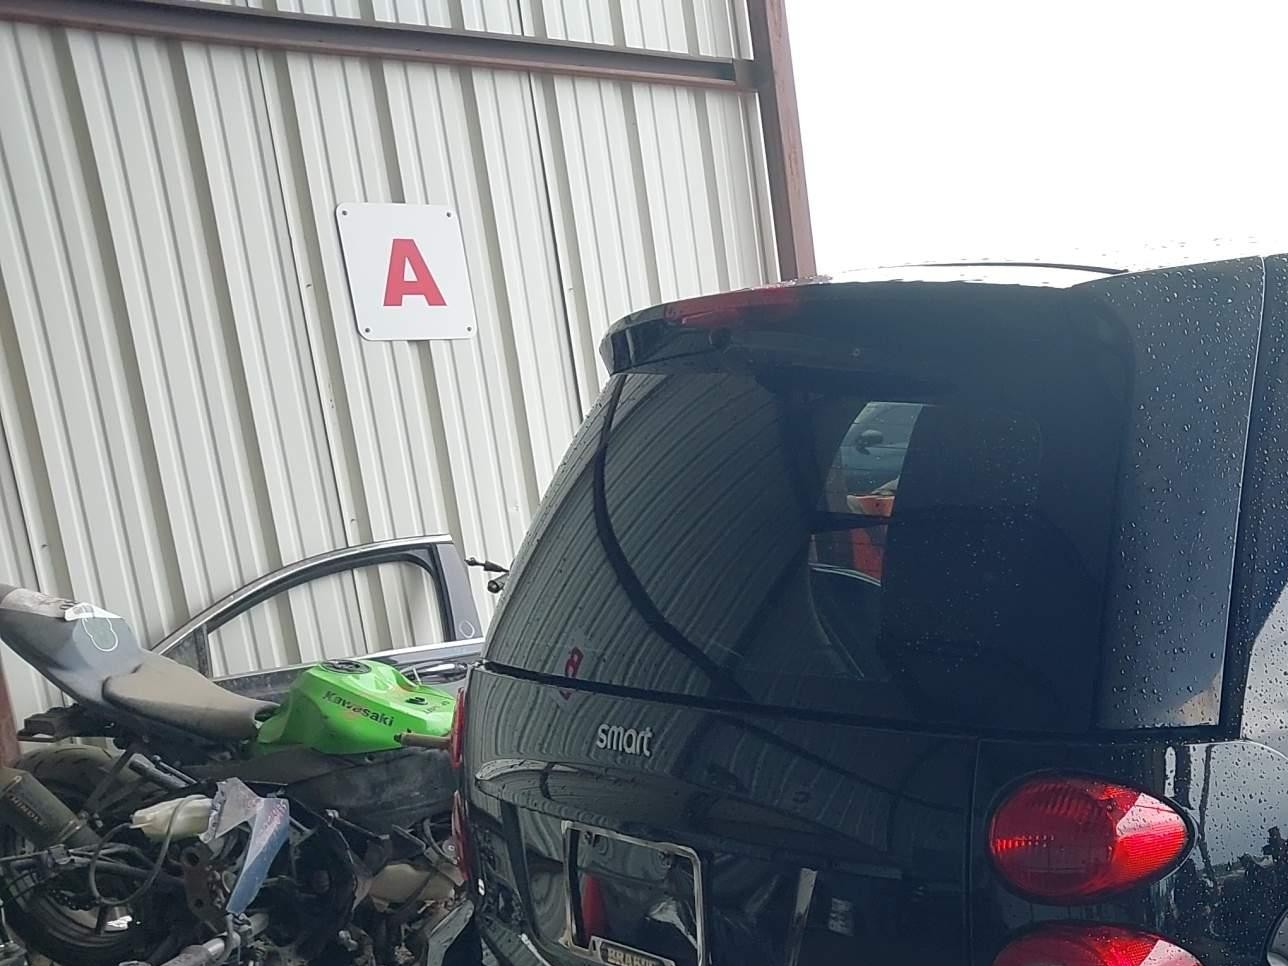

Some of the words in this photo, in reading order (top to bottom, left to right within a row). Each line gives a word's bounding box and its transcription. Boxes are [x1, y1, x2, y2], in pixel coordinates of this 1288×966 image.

[383, 238, 447, 306] A
[322, 690, 395, 727] Kawasaki
[596, 723, 653, 757] smart
